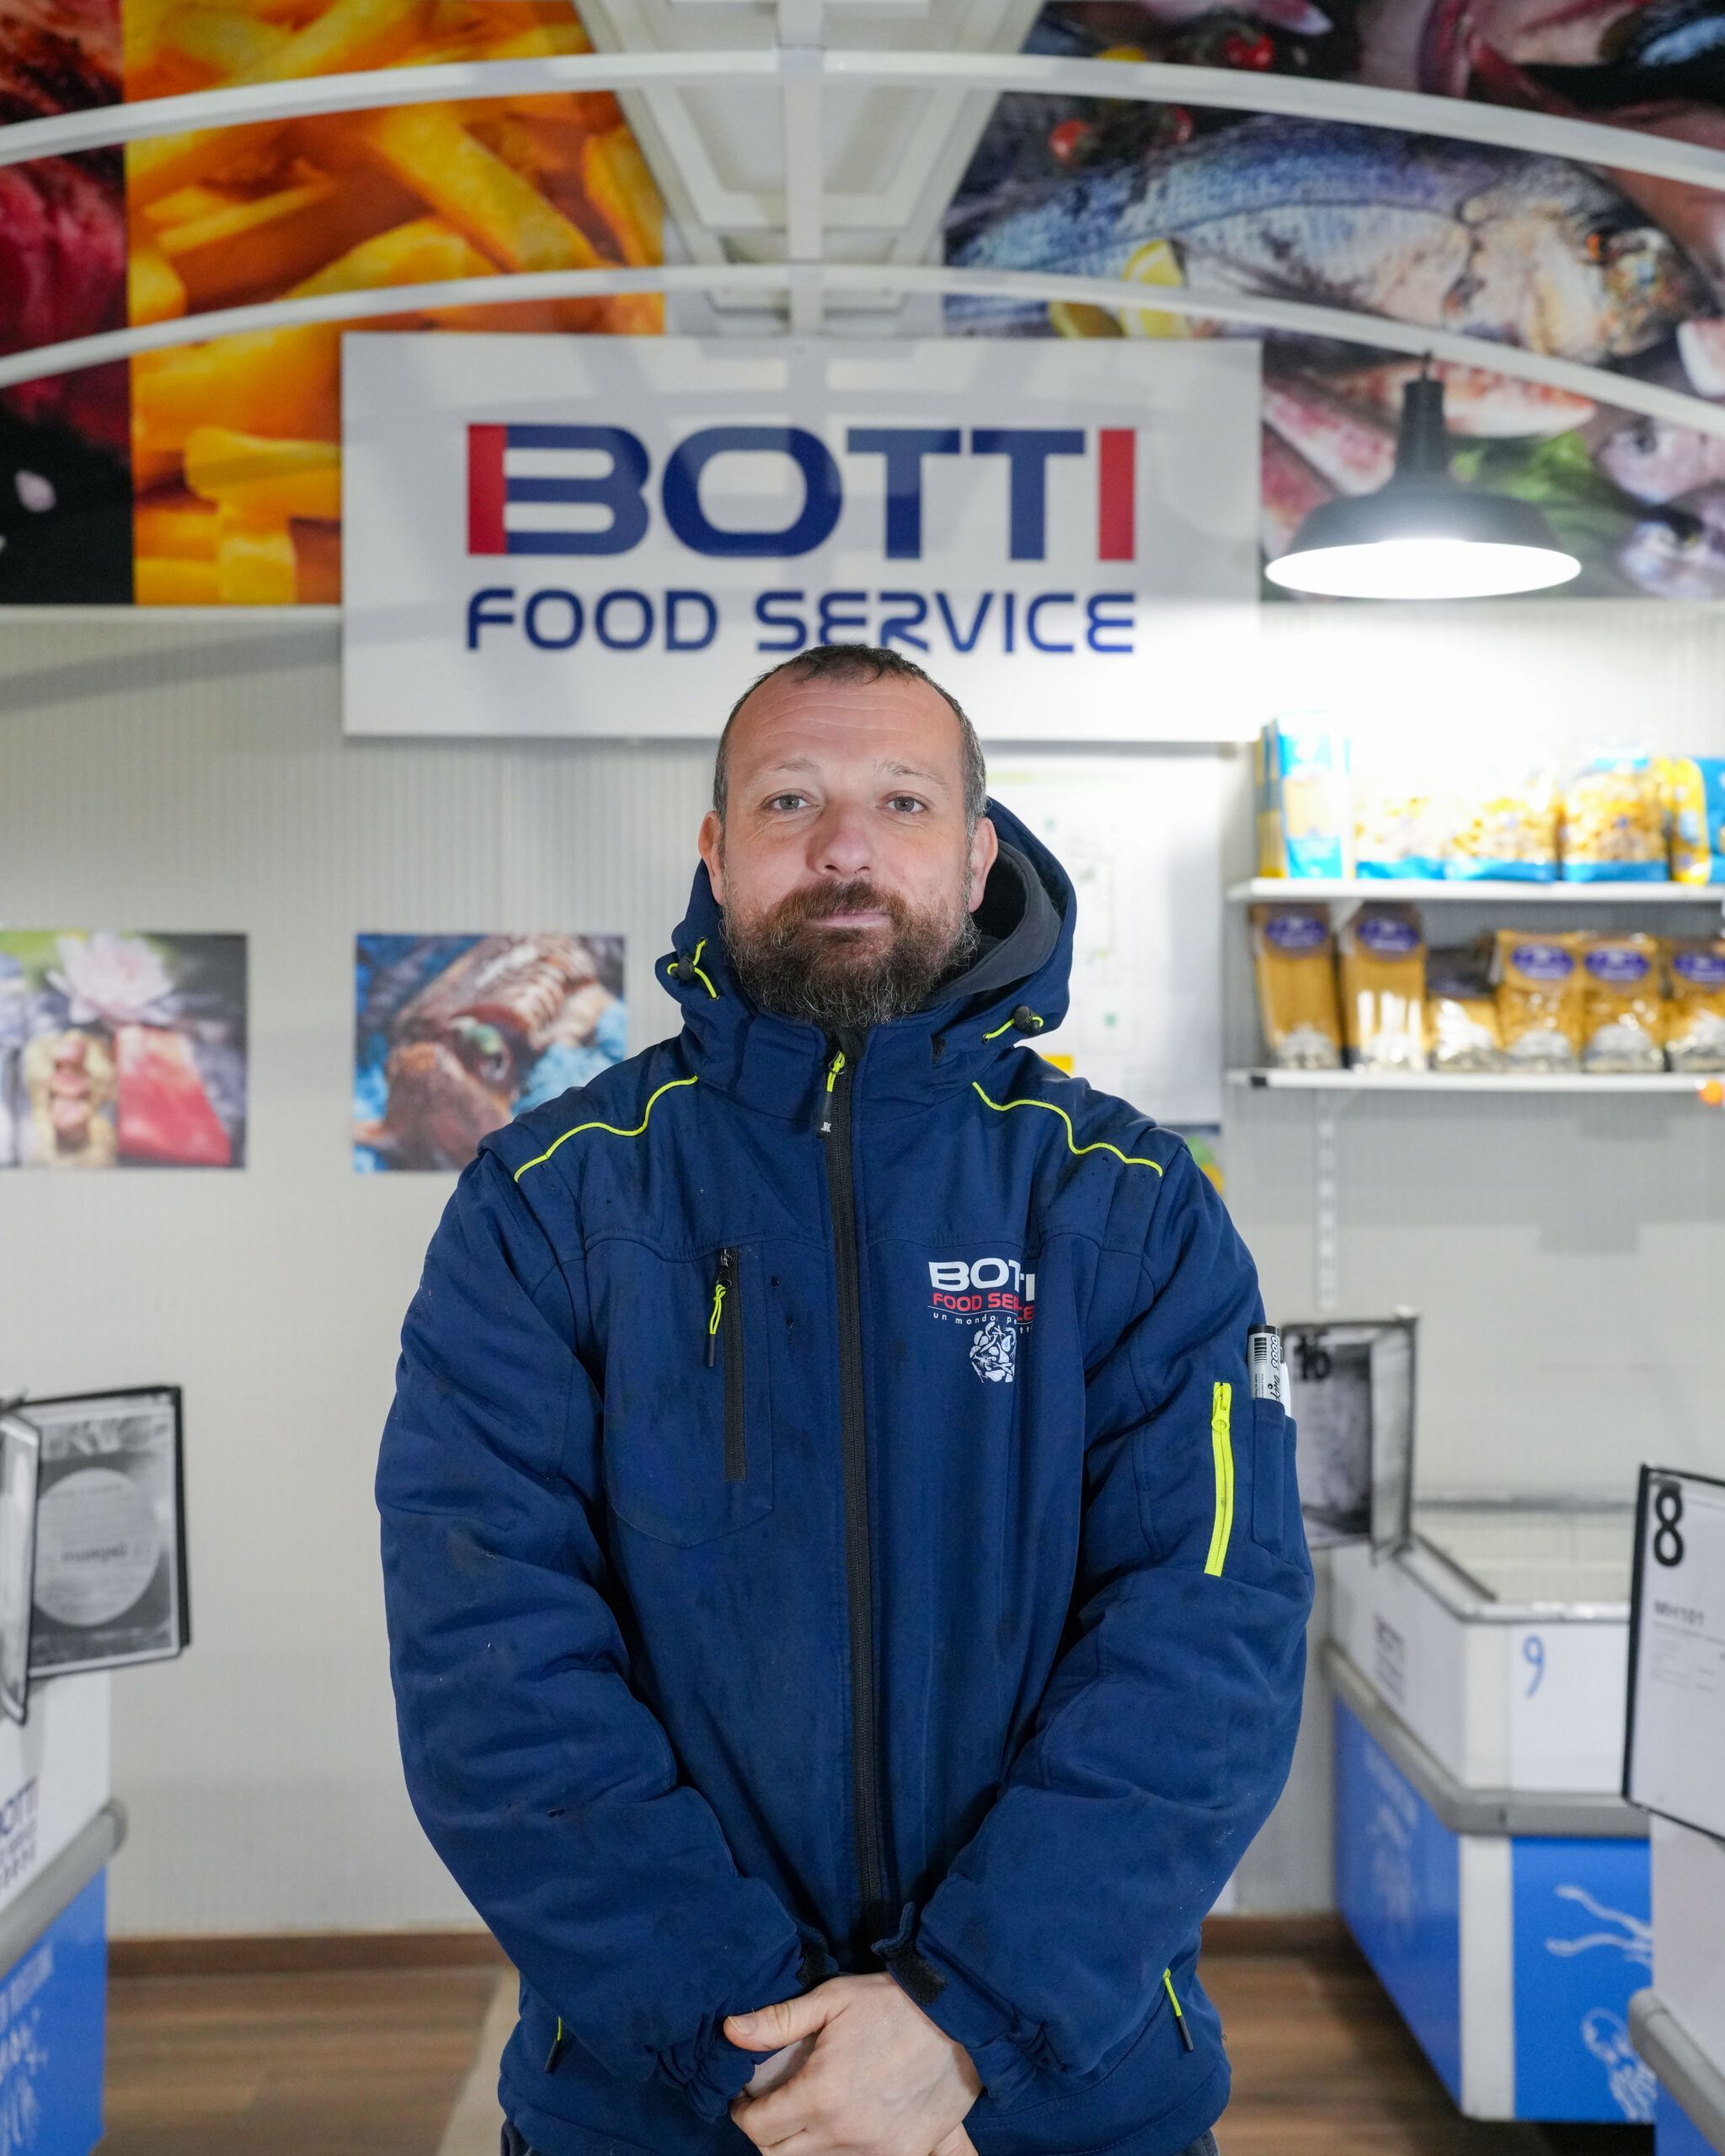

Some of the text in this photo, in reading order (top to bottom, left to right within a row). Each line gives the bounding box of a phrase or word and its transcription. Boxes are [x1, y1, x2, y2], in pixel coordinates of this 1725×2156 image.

[467, 422, 1135, 561] BOTTI
[467, 587, 1136, 654] FOOD SERVICE
[928, 1257, 1036, 1302] BOTI
[933, 1292, 982, 1312] FOOD
[932, 1311, 948, 1321] un
[955, 1314, 996, 1325] mondo
[1653, 1487, 1684, 1567] 8
[1523, 1635, 1544, 1697] 9
